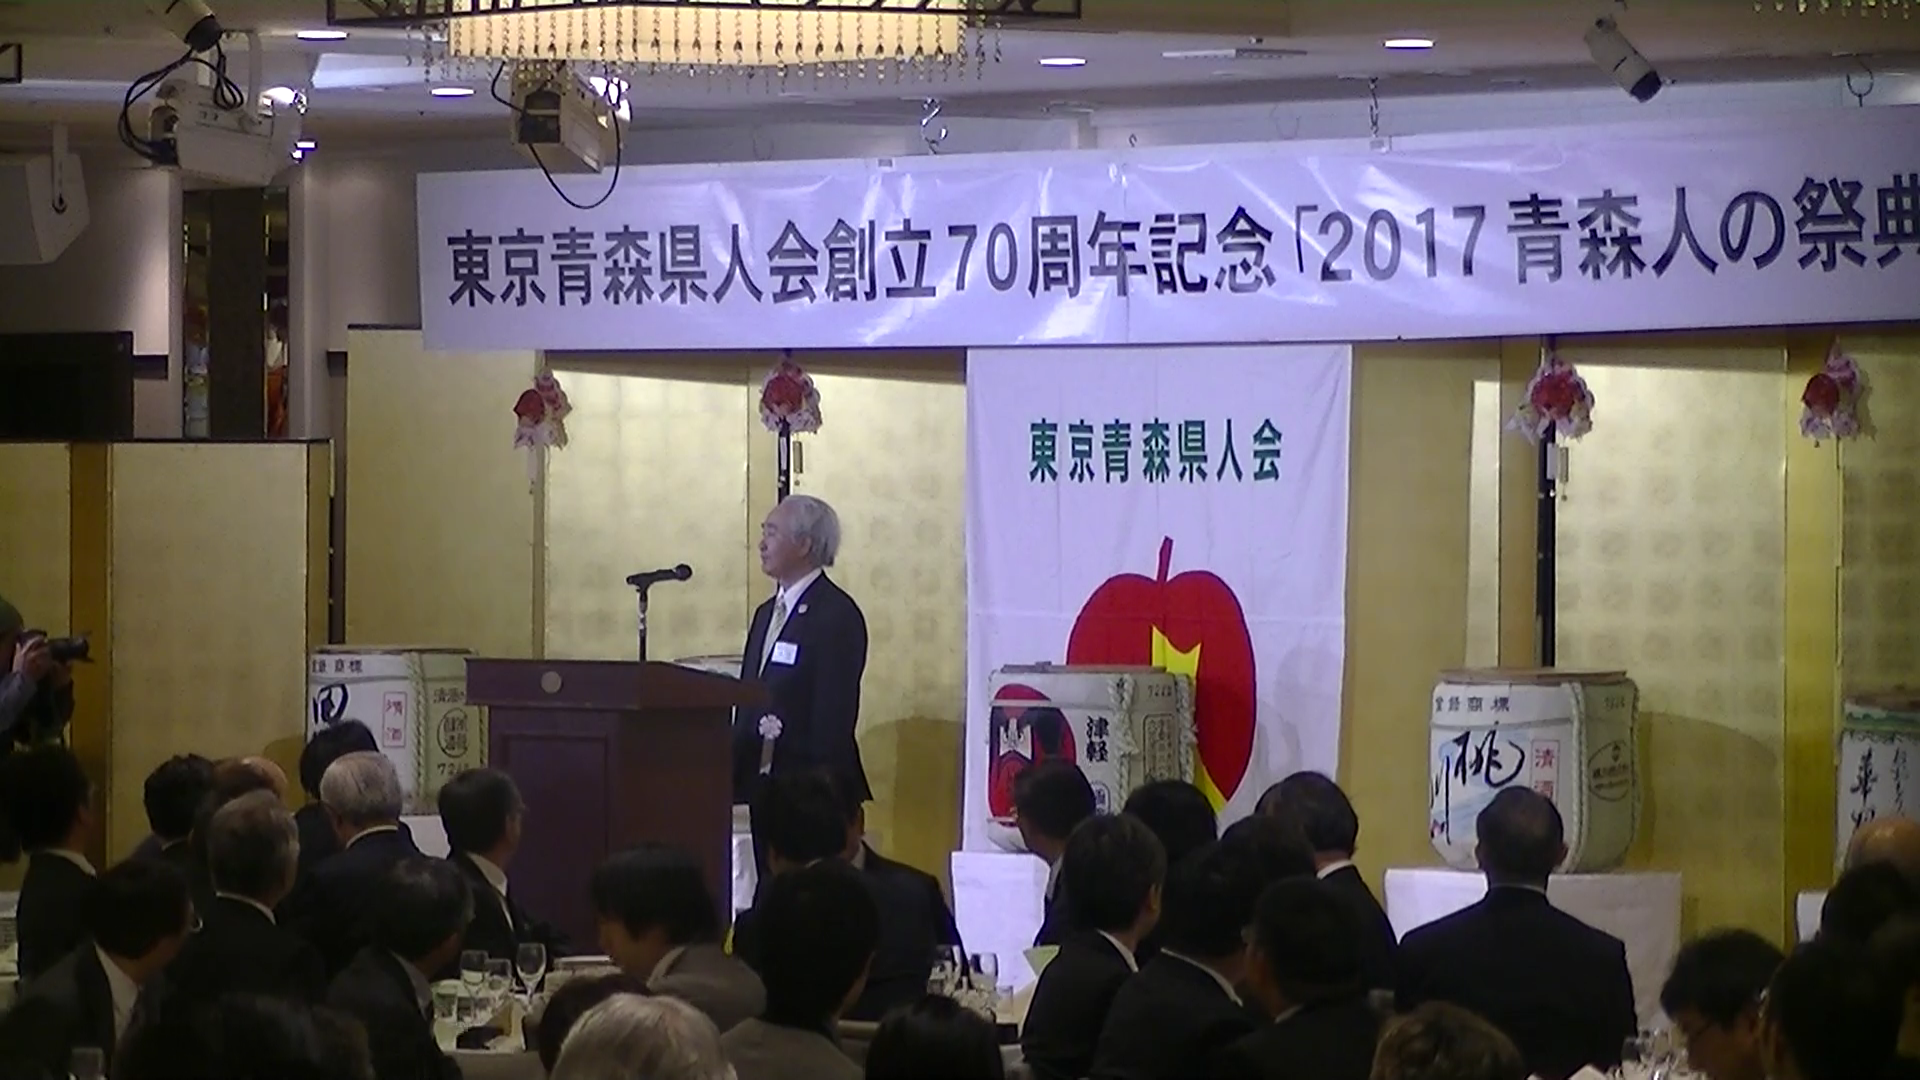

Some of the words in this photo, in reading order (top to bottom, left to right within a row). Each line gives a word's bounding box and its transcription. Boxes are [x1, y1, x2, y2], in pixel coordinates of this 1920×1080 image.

[1029, 418, 1282, 484] 東京青森県人会
[1435, 696, 1510, 712] 登録商標
[1086, 715, 1109, 762] 津軽
[1534, 748, 1555, 798] 清酒
